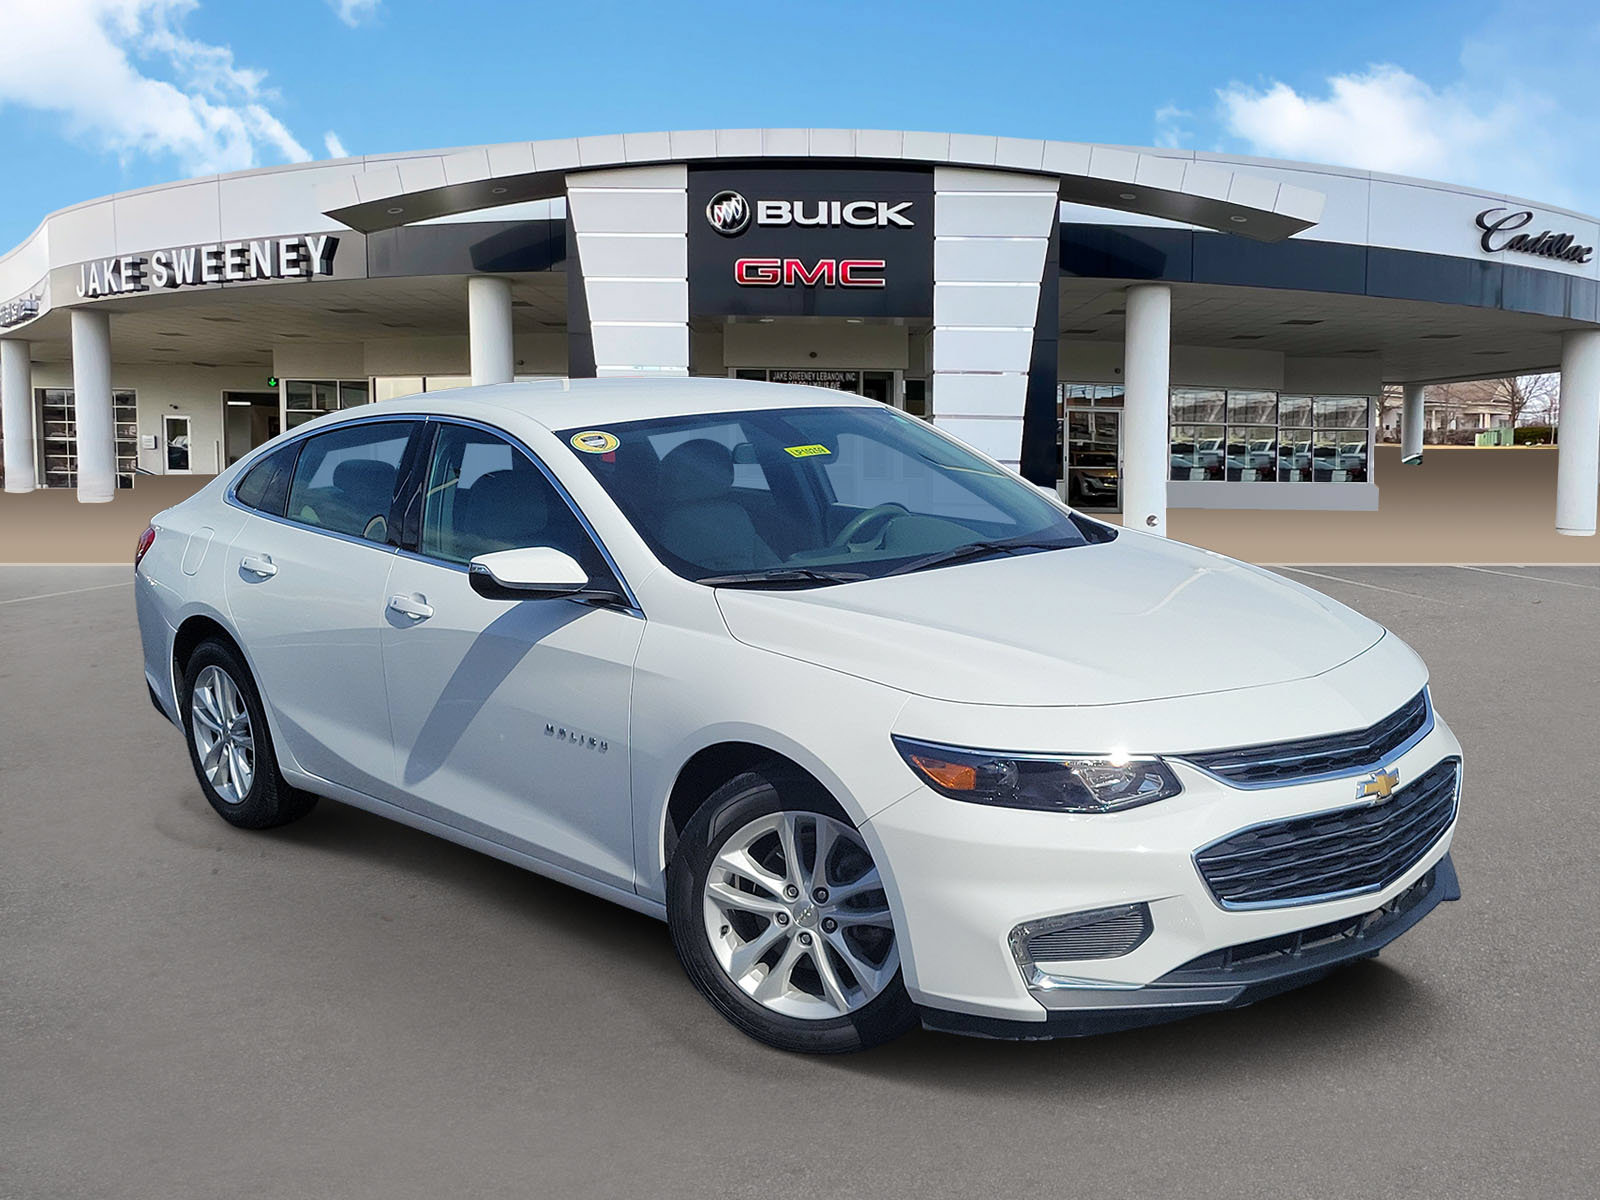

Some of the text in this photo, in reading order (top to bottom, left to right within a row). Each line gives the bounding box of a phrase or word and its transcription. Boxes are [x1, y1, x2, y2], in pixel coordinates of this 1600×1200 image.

[756, 200, 915, 226] BUICK
[1475, 207, 1594, 264] Cadillac
[76, 234, 334, 297] JAKE SWEENEY
[734, 258, 886, 287] GMC
[773, 371, 788, 381] JAKE
[788, 371, 816, 381] SWEENEY
[543, 722, 609, 754] MALIBU
